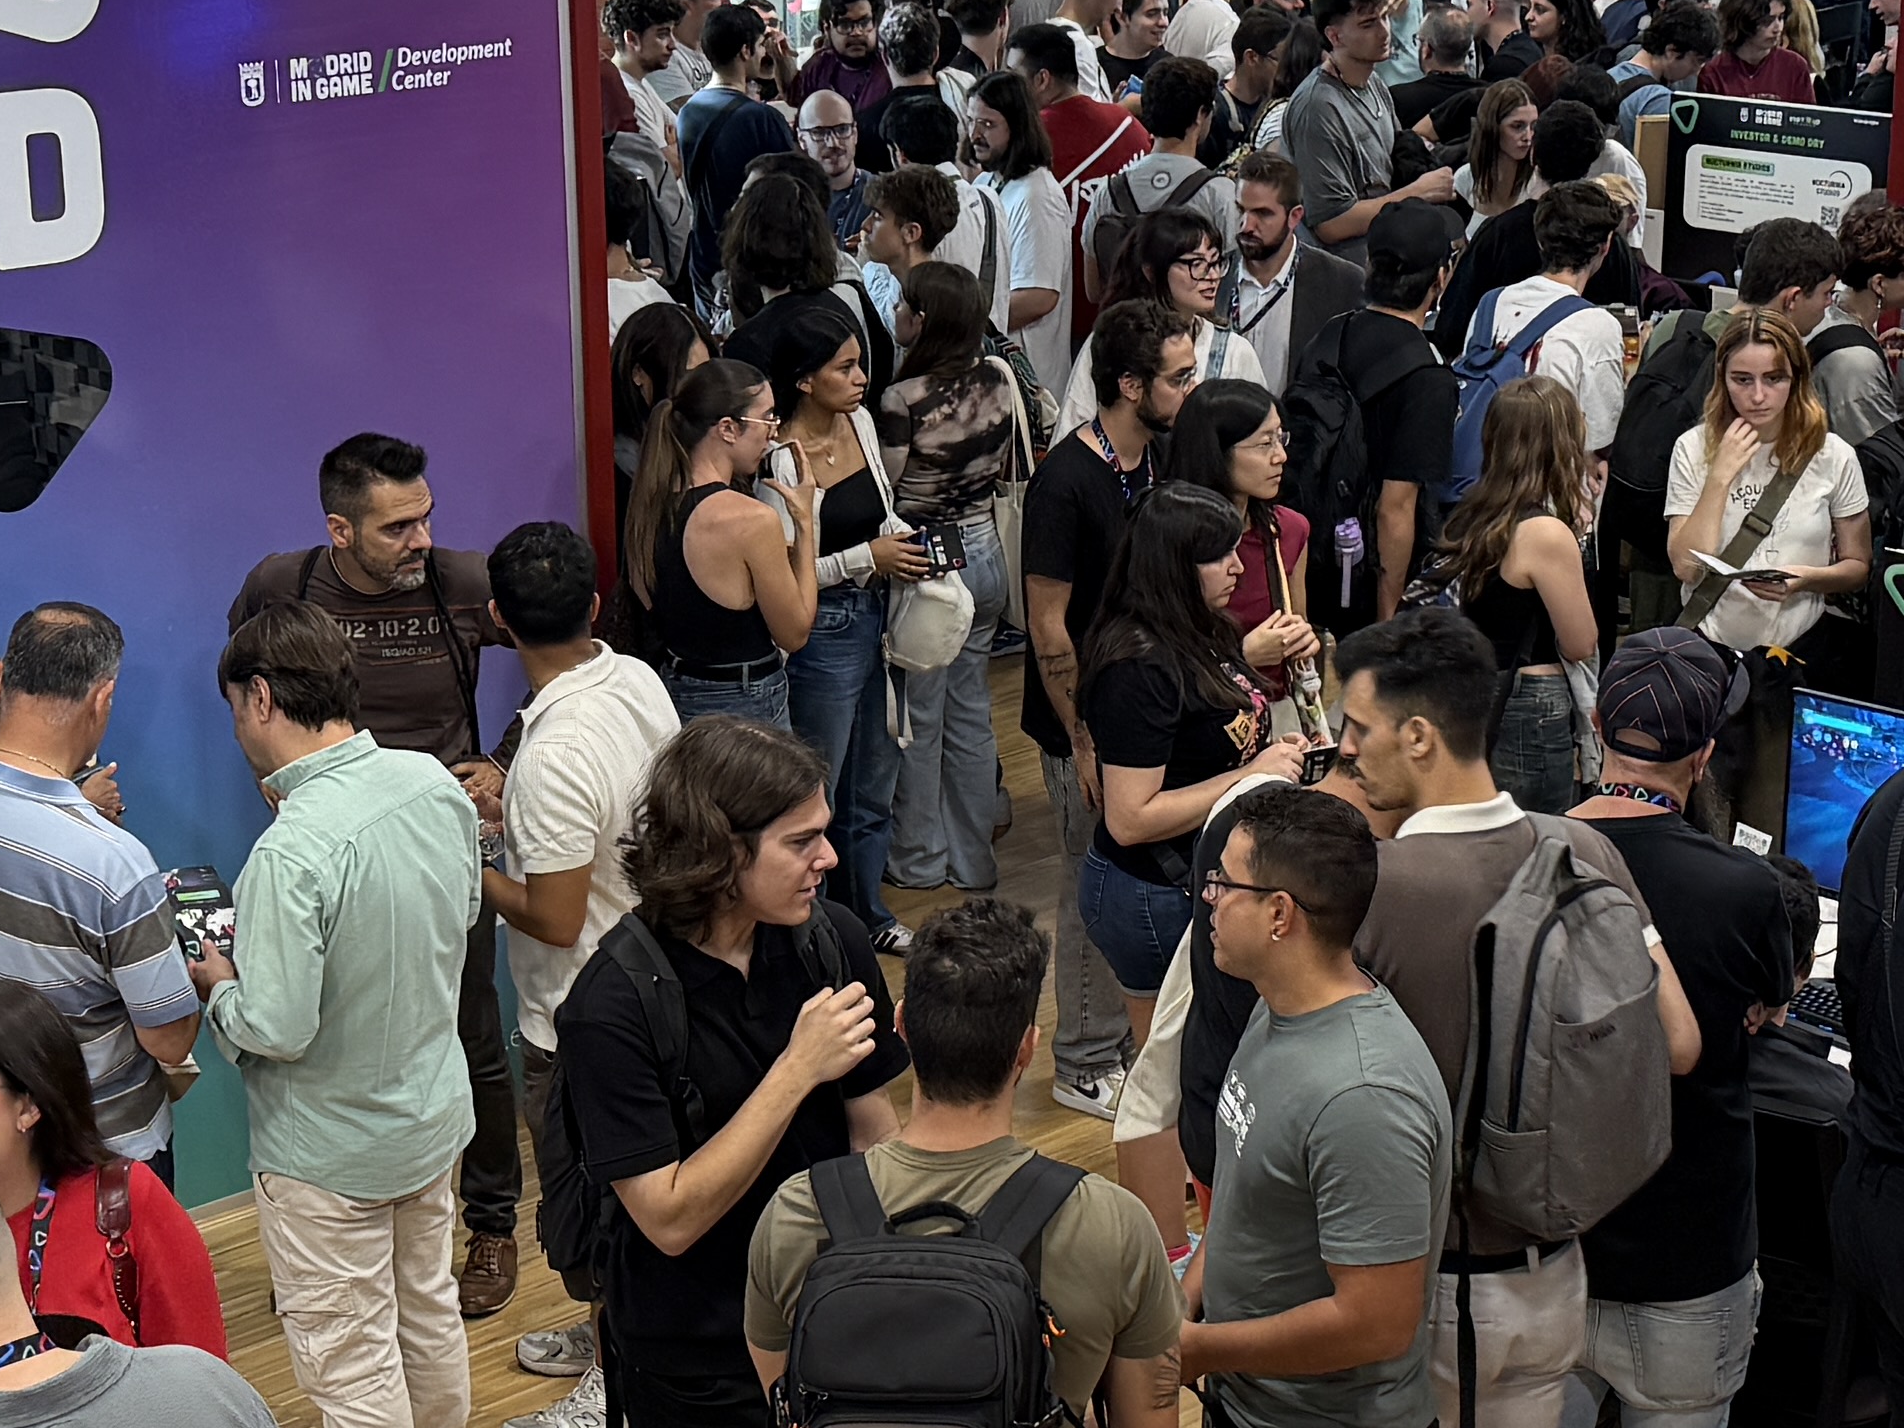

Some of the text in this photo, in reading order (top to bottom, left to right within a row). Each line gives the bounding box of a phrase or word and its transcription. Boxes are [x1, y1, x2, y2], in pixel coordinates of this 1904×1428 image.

[398, 38, 512, 68] Development
[291, 73, 374, 102] IN GAME
[392, 69, 451, 91] Center
